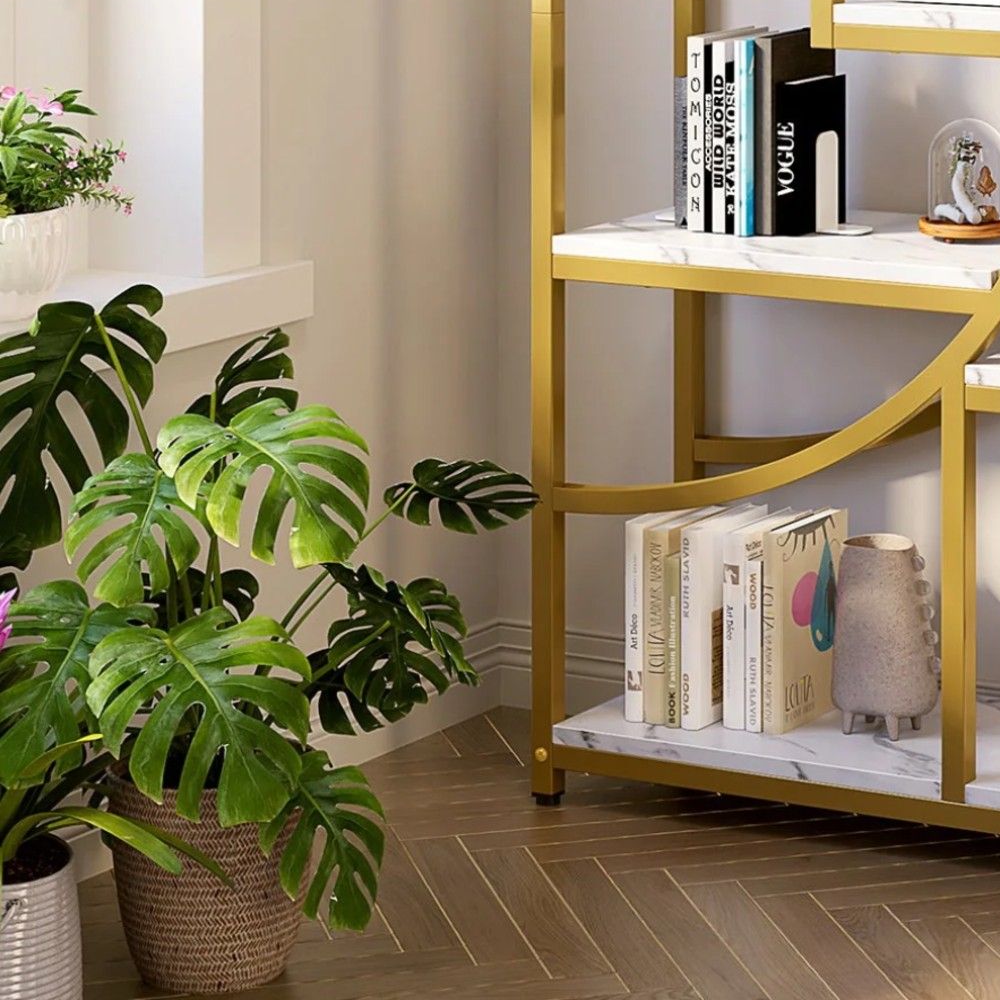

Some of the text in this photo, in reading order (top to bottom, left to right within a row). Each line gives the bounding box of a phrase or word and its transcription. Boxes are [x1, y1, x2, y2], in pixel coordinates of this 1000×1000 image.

[713, 74, 724, 189] WILD WORLD
[726, 82, 735, 197] KATE MOSS
[777, 122, 794, 196] VOGUE
[682, 537, 690, 582] SLAVID
[629, 613, 638, 635] Déco
[668, 595, 676, 648] Illustration
[682, 584, 690, 618] RUTH
[630, 636, 638, 650] Art
[749, 572, 757, 726] WOOD RUTH SLAVID
[668, 691, 676, 724] BOOK
